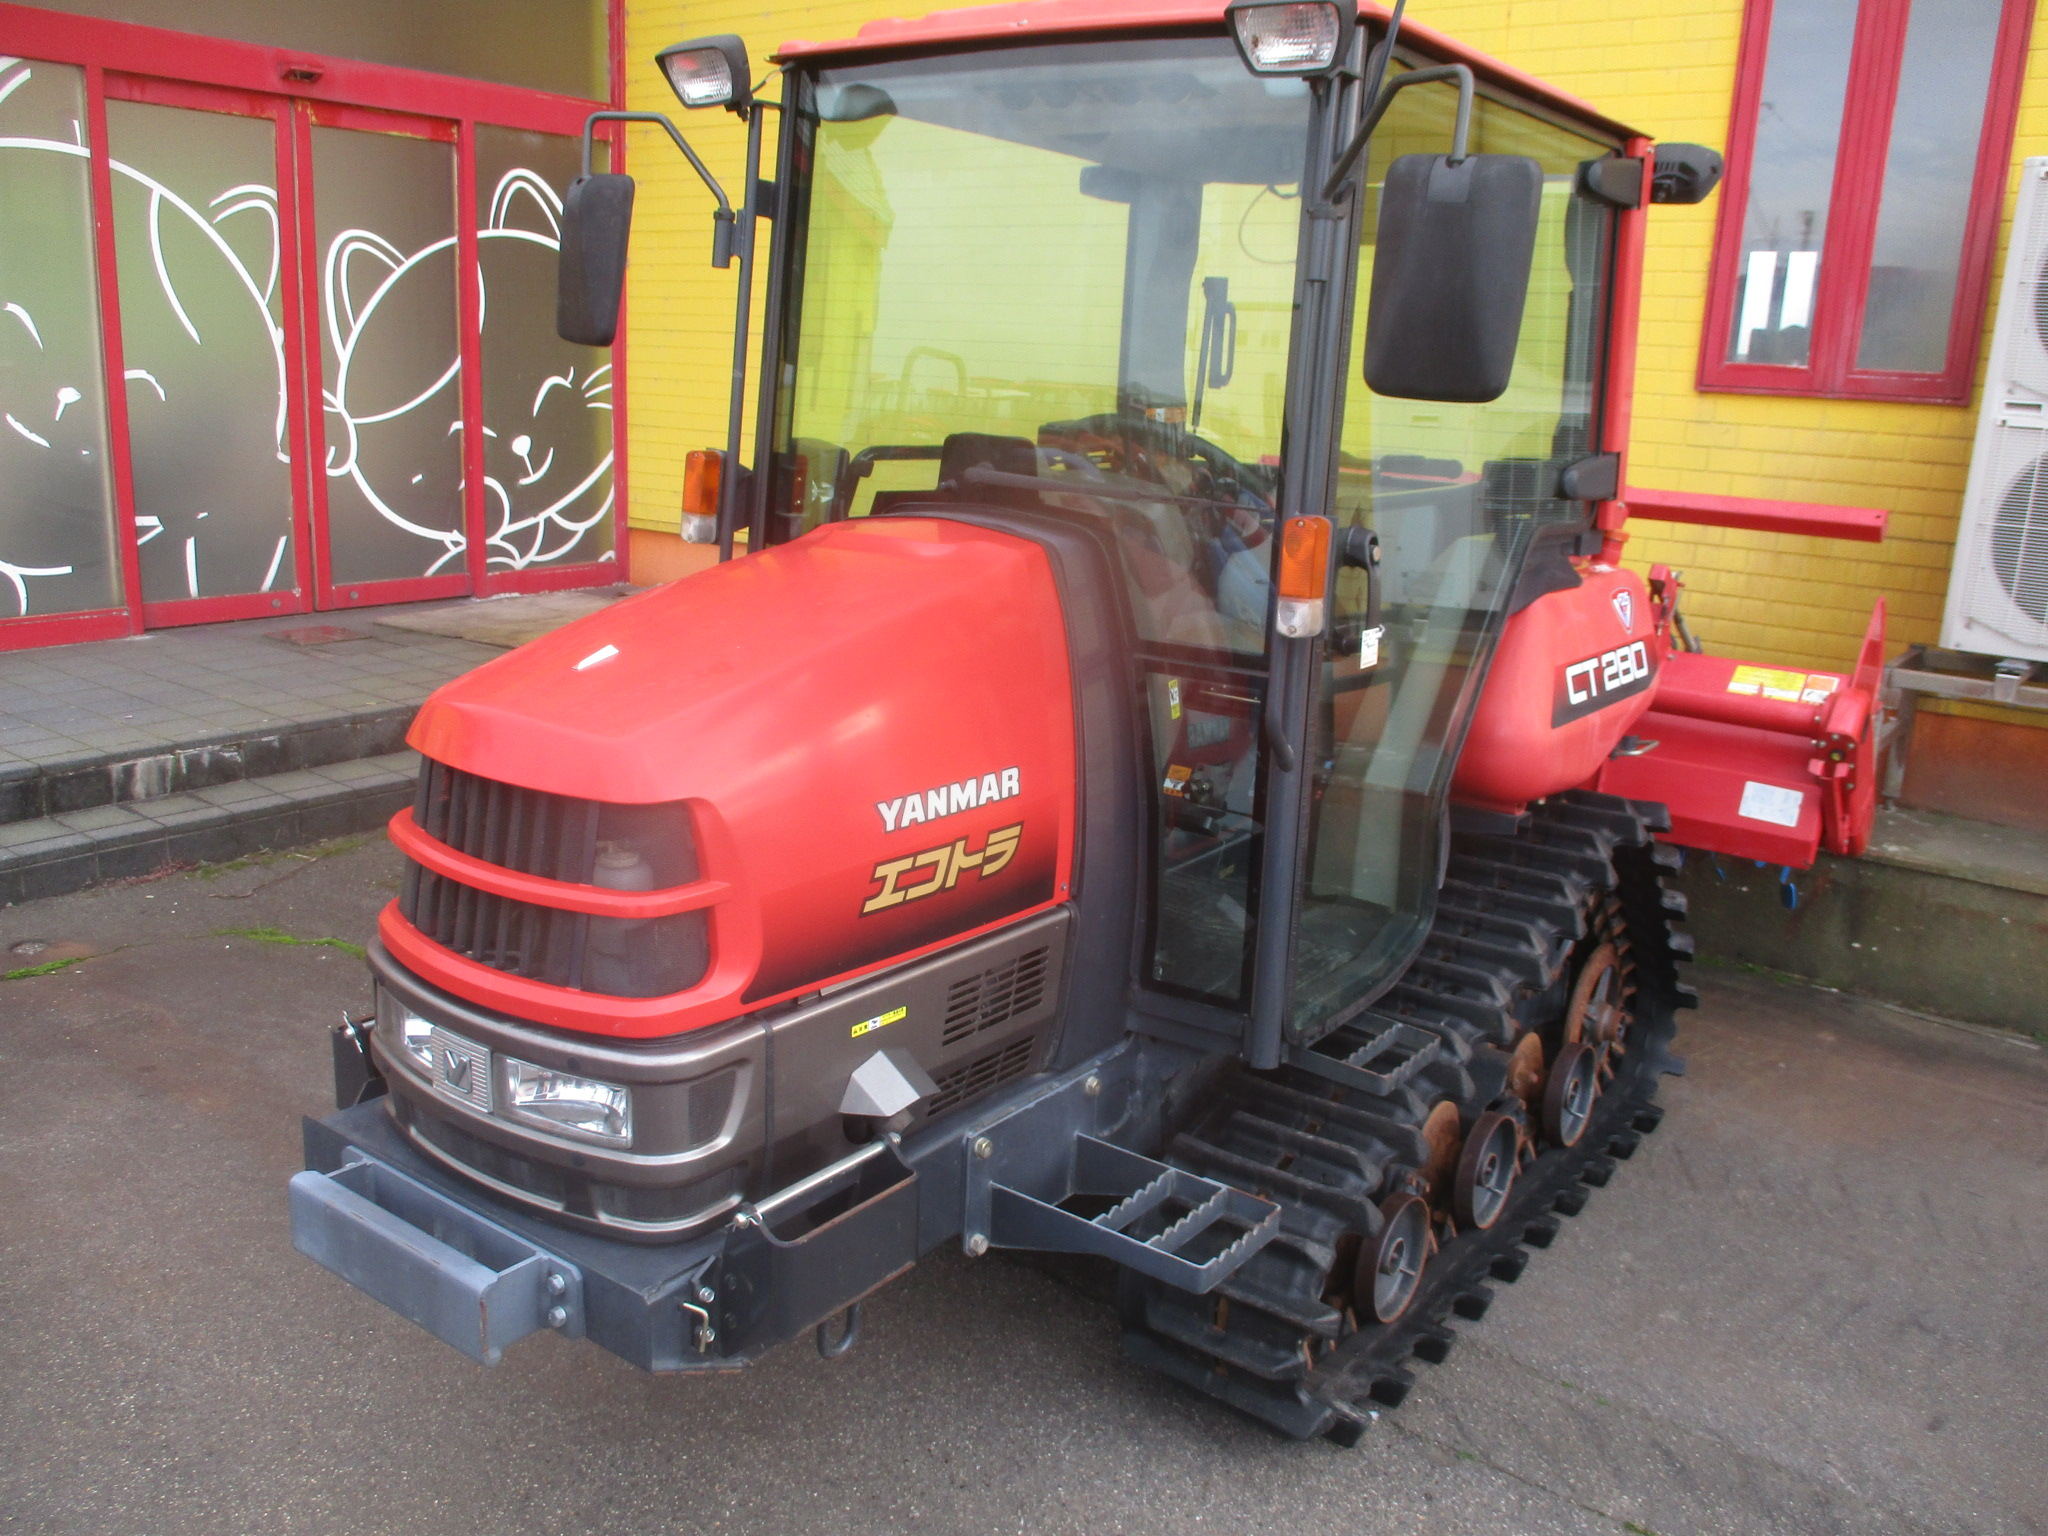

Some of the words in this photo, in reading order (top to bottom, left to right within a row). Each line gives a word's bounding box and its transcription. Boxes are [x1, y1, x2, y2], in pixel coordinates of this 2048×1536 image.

[1566, 641, 1648, 705] CT280
[877, 766, 1020, 832] YANMAR
[862, 824, 1022, 914] エコトラ
